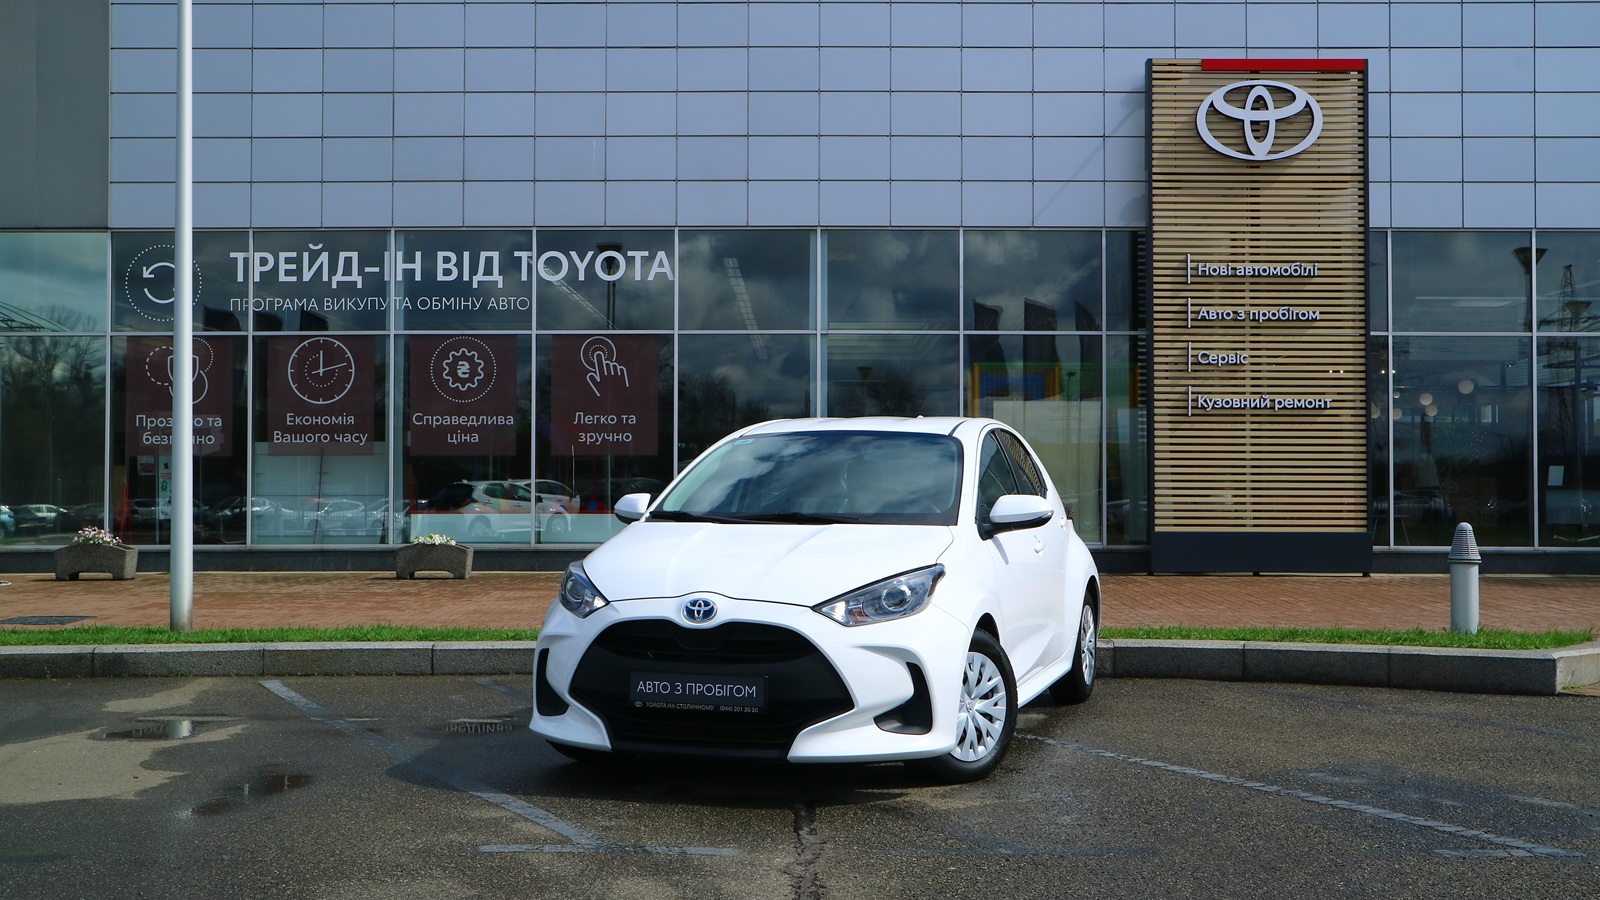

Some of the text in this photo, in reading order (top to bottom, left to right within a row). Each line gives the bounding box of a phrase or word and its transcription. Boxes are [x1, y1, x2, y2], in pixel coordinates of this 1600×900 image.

[229, 243, 675, 289] ТРЕЙД-ІН ВІД TOYOTA
[1197, 262, 1318, 276] Нові автомобілі
[230, 297, 530, 311] ПРОГРАМА ВИКУПУ ТА ОБМІНУ АВТО
[1197, 307, 1320, 323] Авто з пробігом
[1197, 351, 1249, 367] Сервіс
[1197, 394, 1333, 412] Кузовний ремонт
[135, 414, 223, 430] Прозо та
[286, 413, 355, 426] Економія
[412, 412, 514, 428] Справедлива
[573, 412, 637, 425] Легко та
[143, 431, 215, 445] безно
[273, 430, 368, 446] Вашого часу
[447, 431, 479, 445] ціна
[578, 432, 632, 445] зручно
[636, 680, 671, 694] АВТО
[686, 683, 756, 698] ПРОБІГОМ
[645, 701, 667, 709] ТОЙОТА
